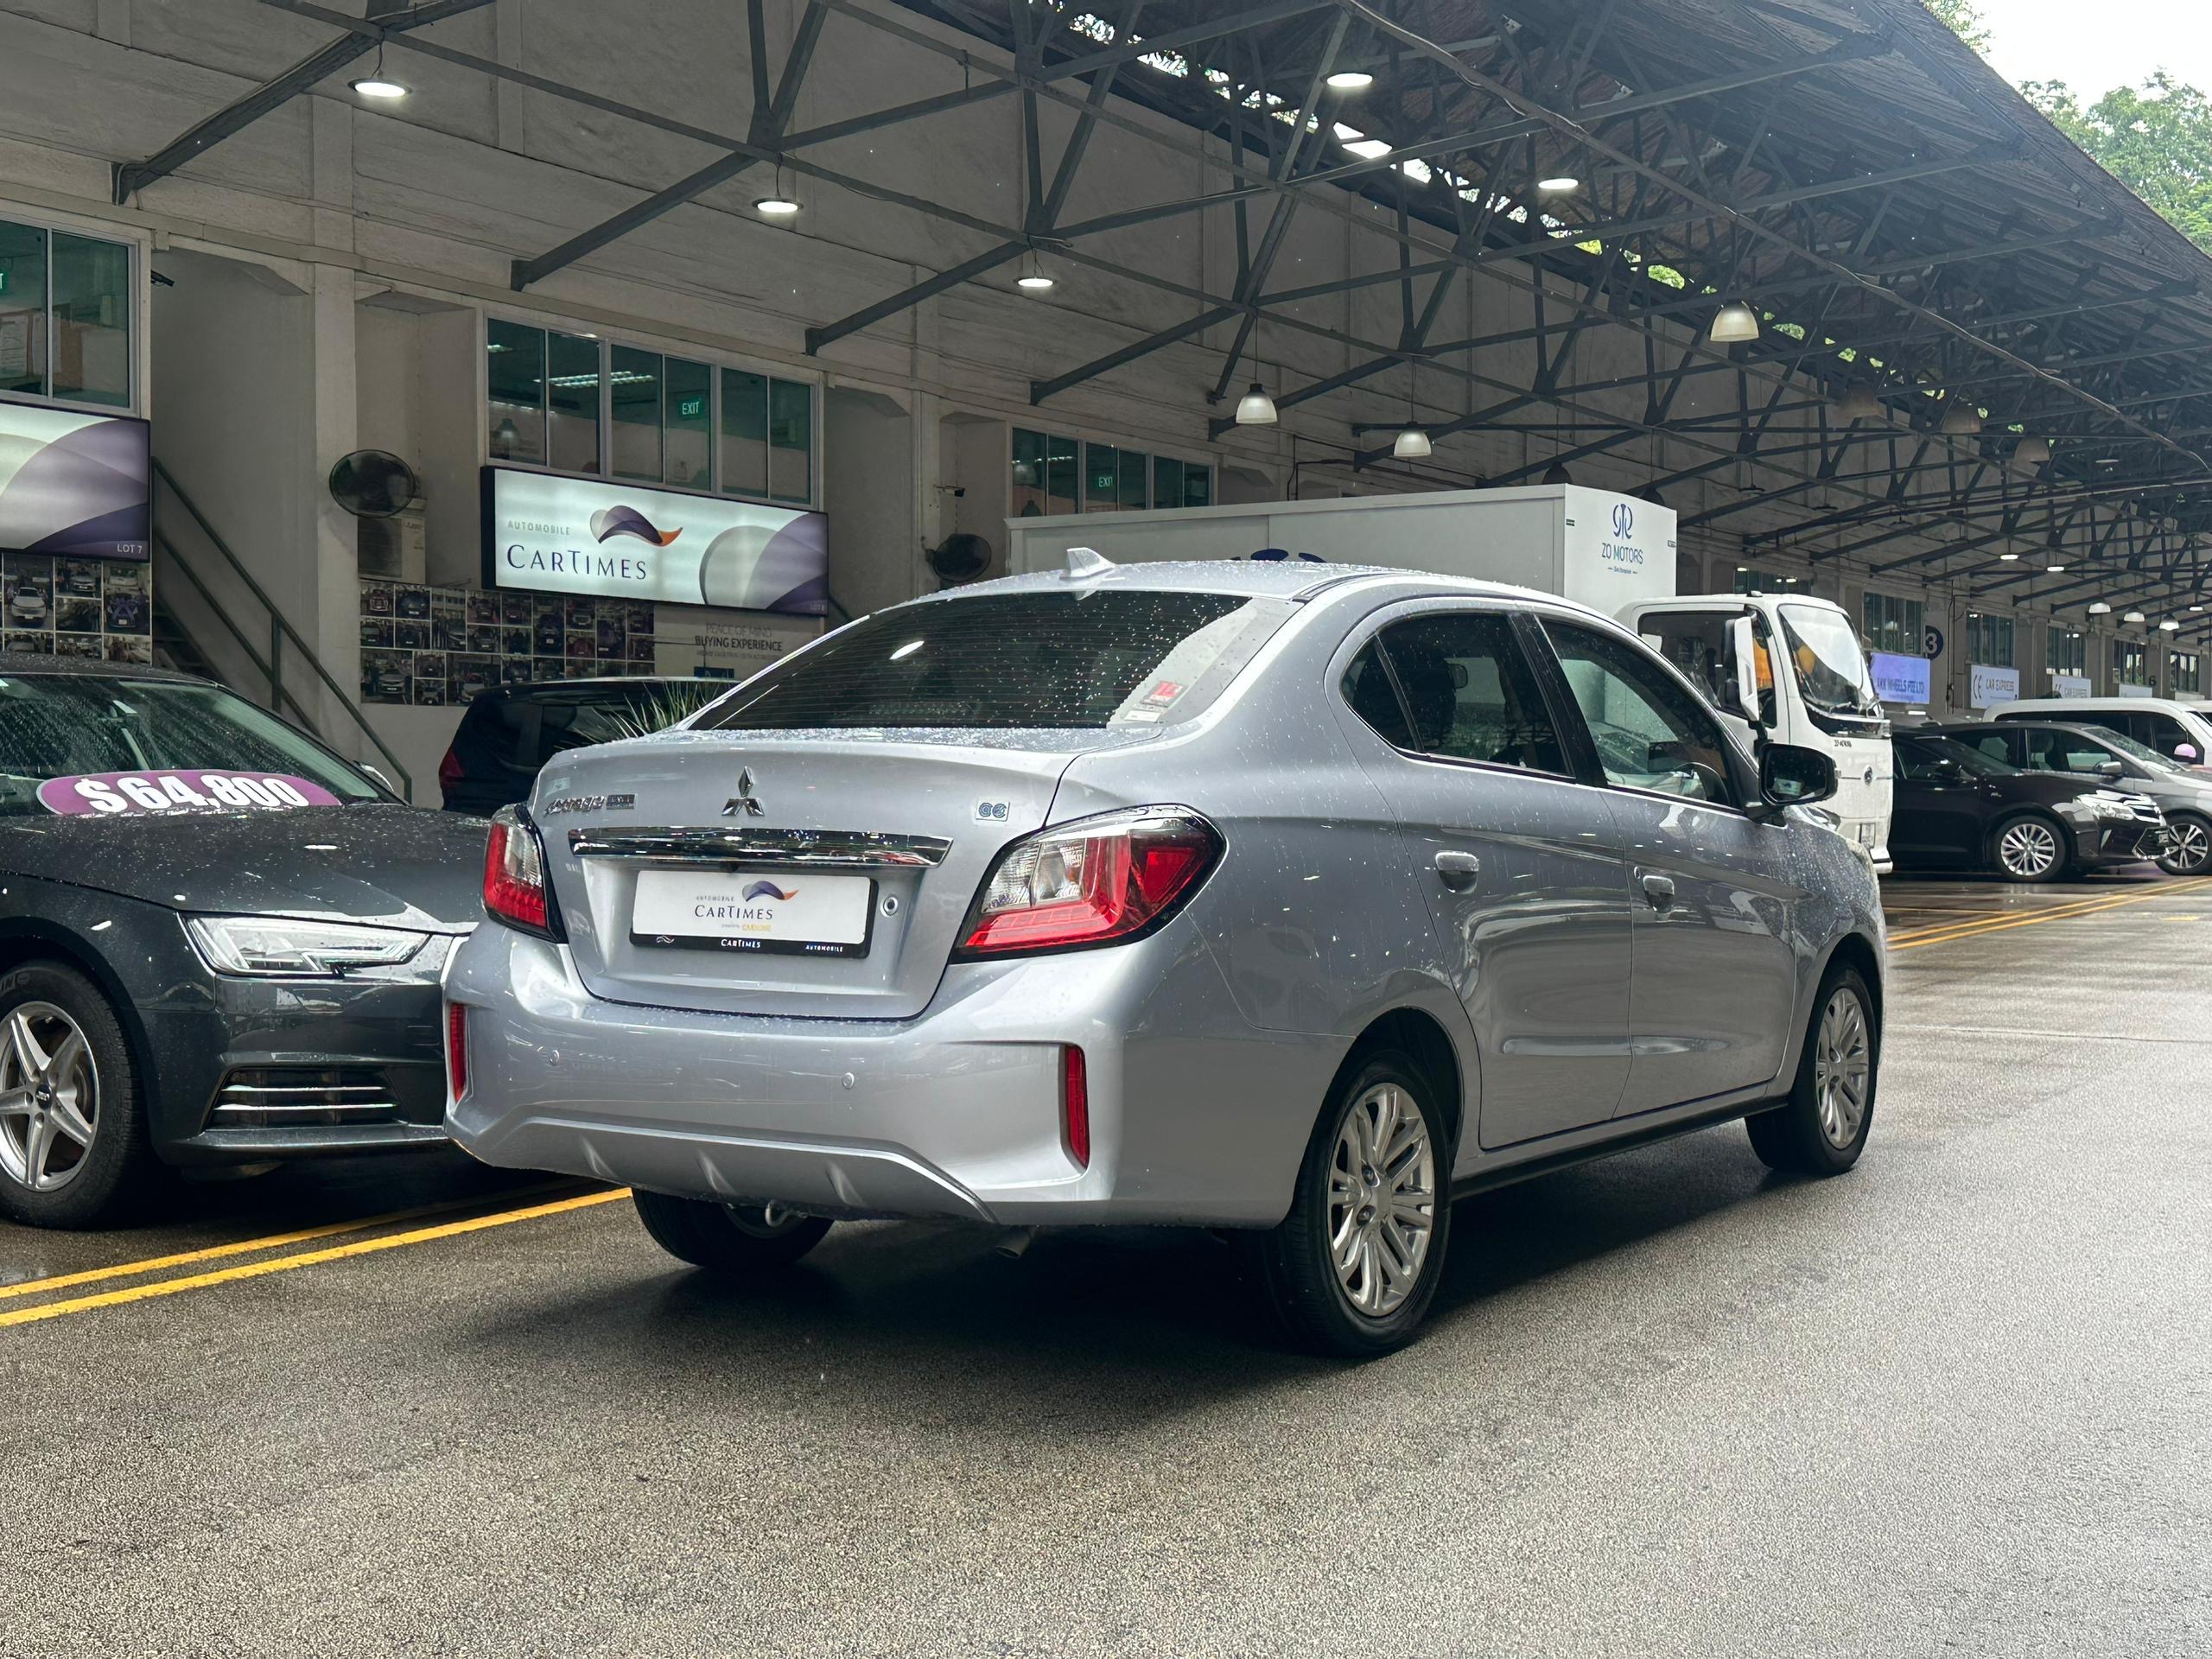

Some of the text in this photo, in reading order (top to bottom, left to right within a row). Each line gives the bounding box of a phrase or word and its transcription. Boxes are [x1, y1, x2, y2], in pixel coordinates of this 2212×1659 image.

[682, 401, 700, 416] EXIT
[1098, 476, 1113, 488] EXIT
[507, 520, 571, 536] AUTOMOBILE
[117, 543, 143, 554] LOT 7
[1613, 544, 1643, 564] MOTORS
[506, 544, 646, 580] CARTIMES
[695, 635, 783, 652] BUYING EXPERIENCE
[1925, 632, 1936, 654] 3
[694, 905, 773, 920] CARTIMES
[721, 938, 761, 949] CARTIMES
